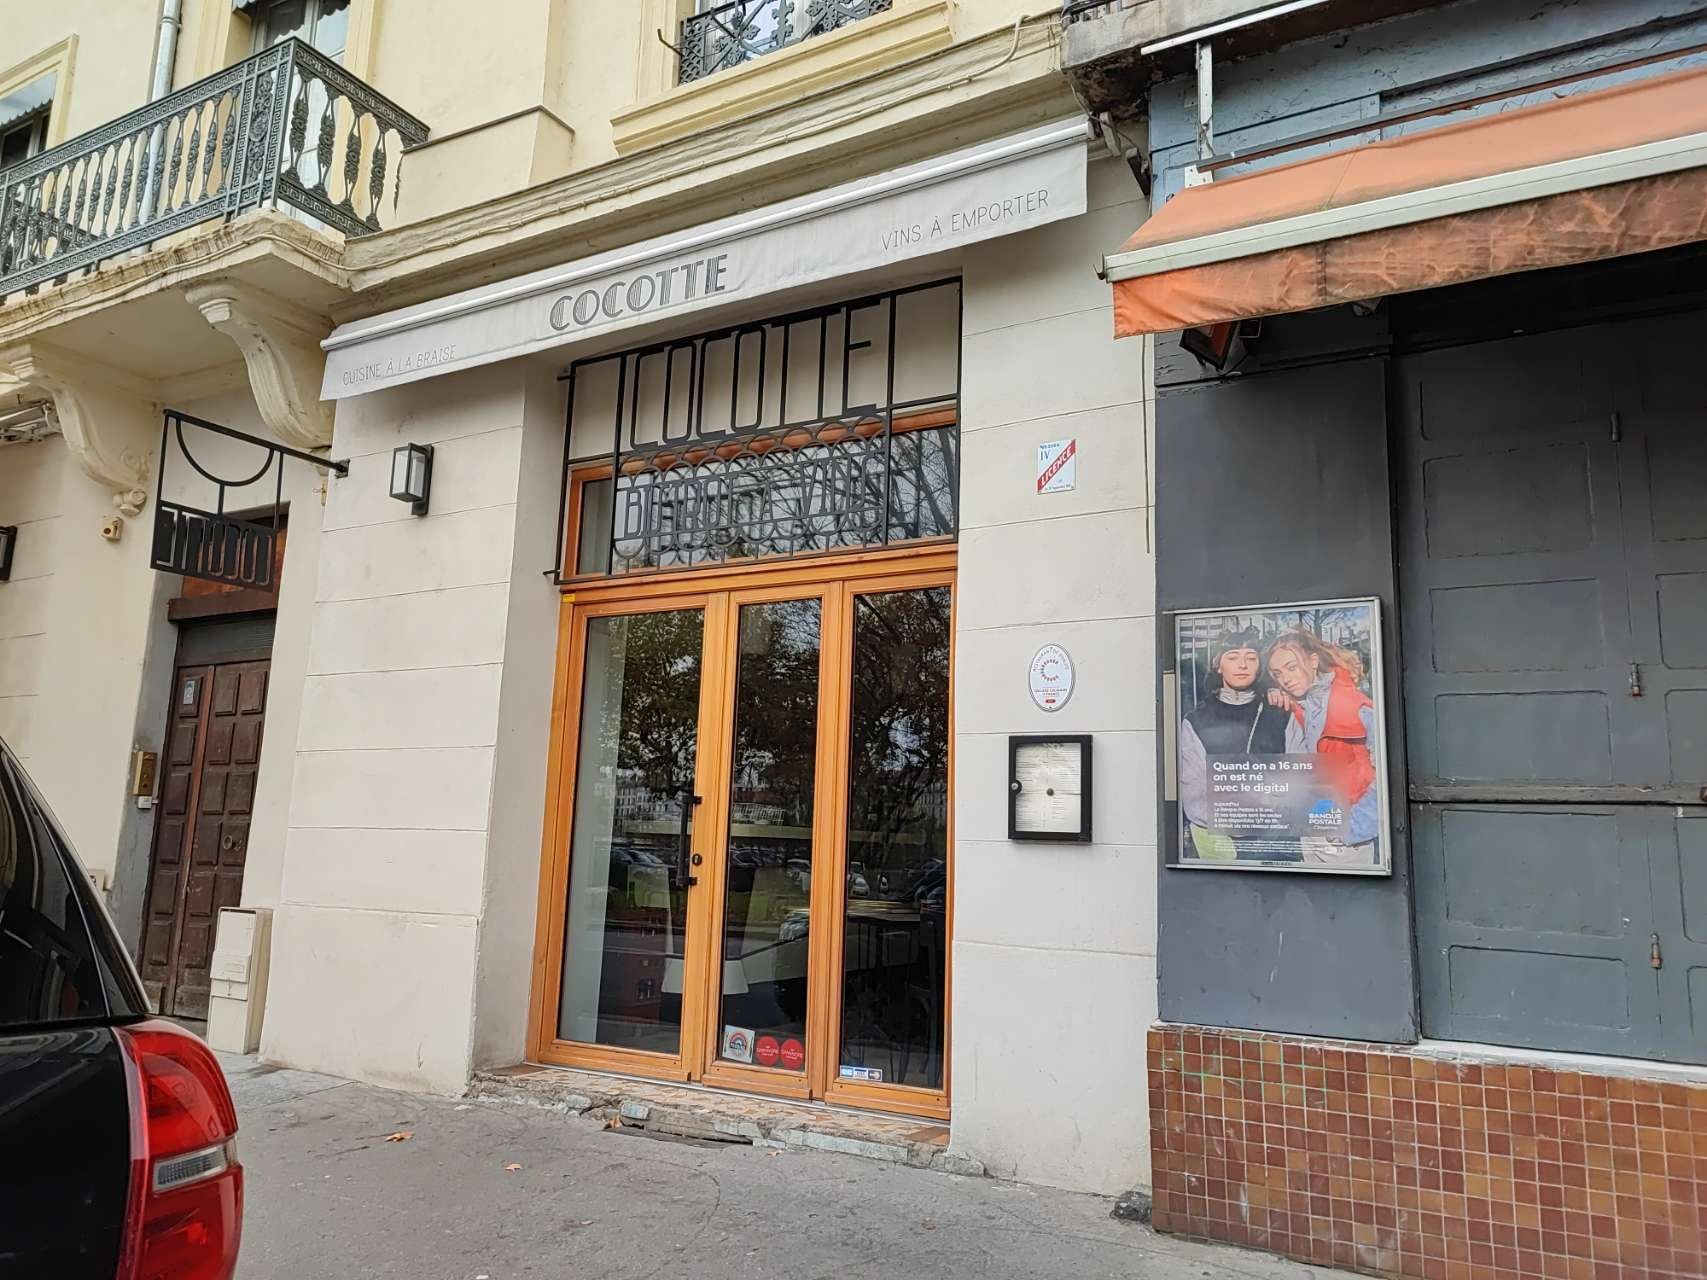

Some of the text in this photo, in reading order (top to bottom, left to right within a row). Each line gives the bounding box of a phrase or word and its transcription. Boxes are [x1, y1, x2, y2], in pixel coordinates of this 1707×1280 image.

[882, 189, 1049, 250] VINS À EMPORTER
[550, 254, 728, 331] COCOTTE
[342, 362, 381, 386] CUISINE
[399, 355, 412, 372] LA
[416, 344, 457, 368] BRAISE
[630, 298, 881, 451] COCOTTE
[1041, 446, 1072, 486] LICENCE
[1213, 761, 1313, 772] Quand on a 16 ans
[1213, 772, 1264, 782] on est né
[1213, 783, 1289, 794] avec le digital
